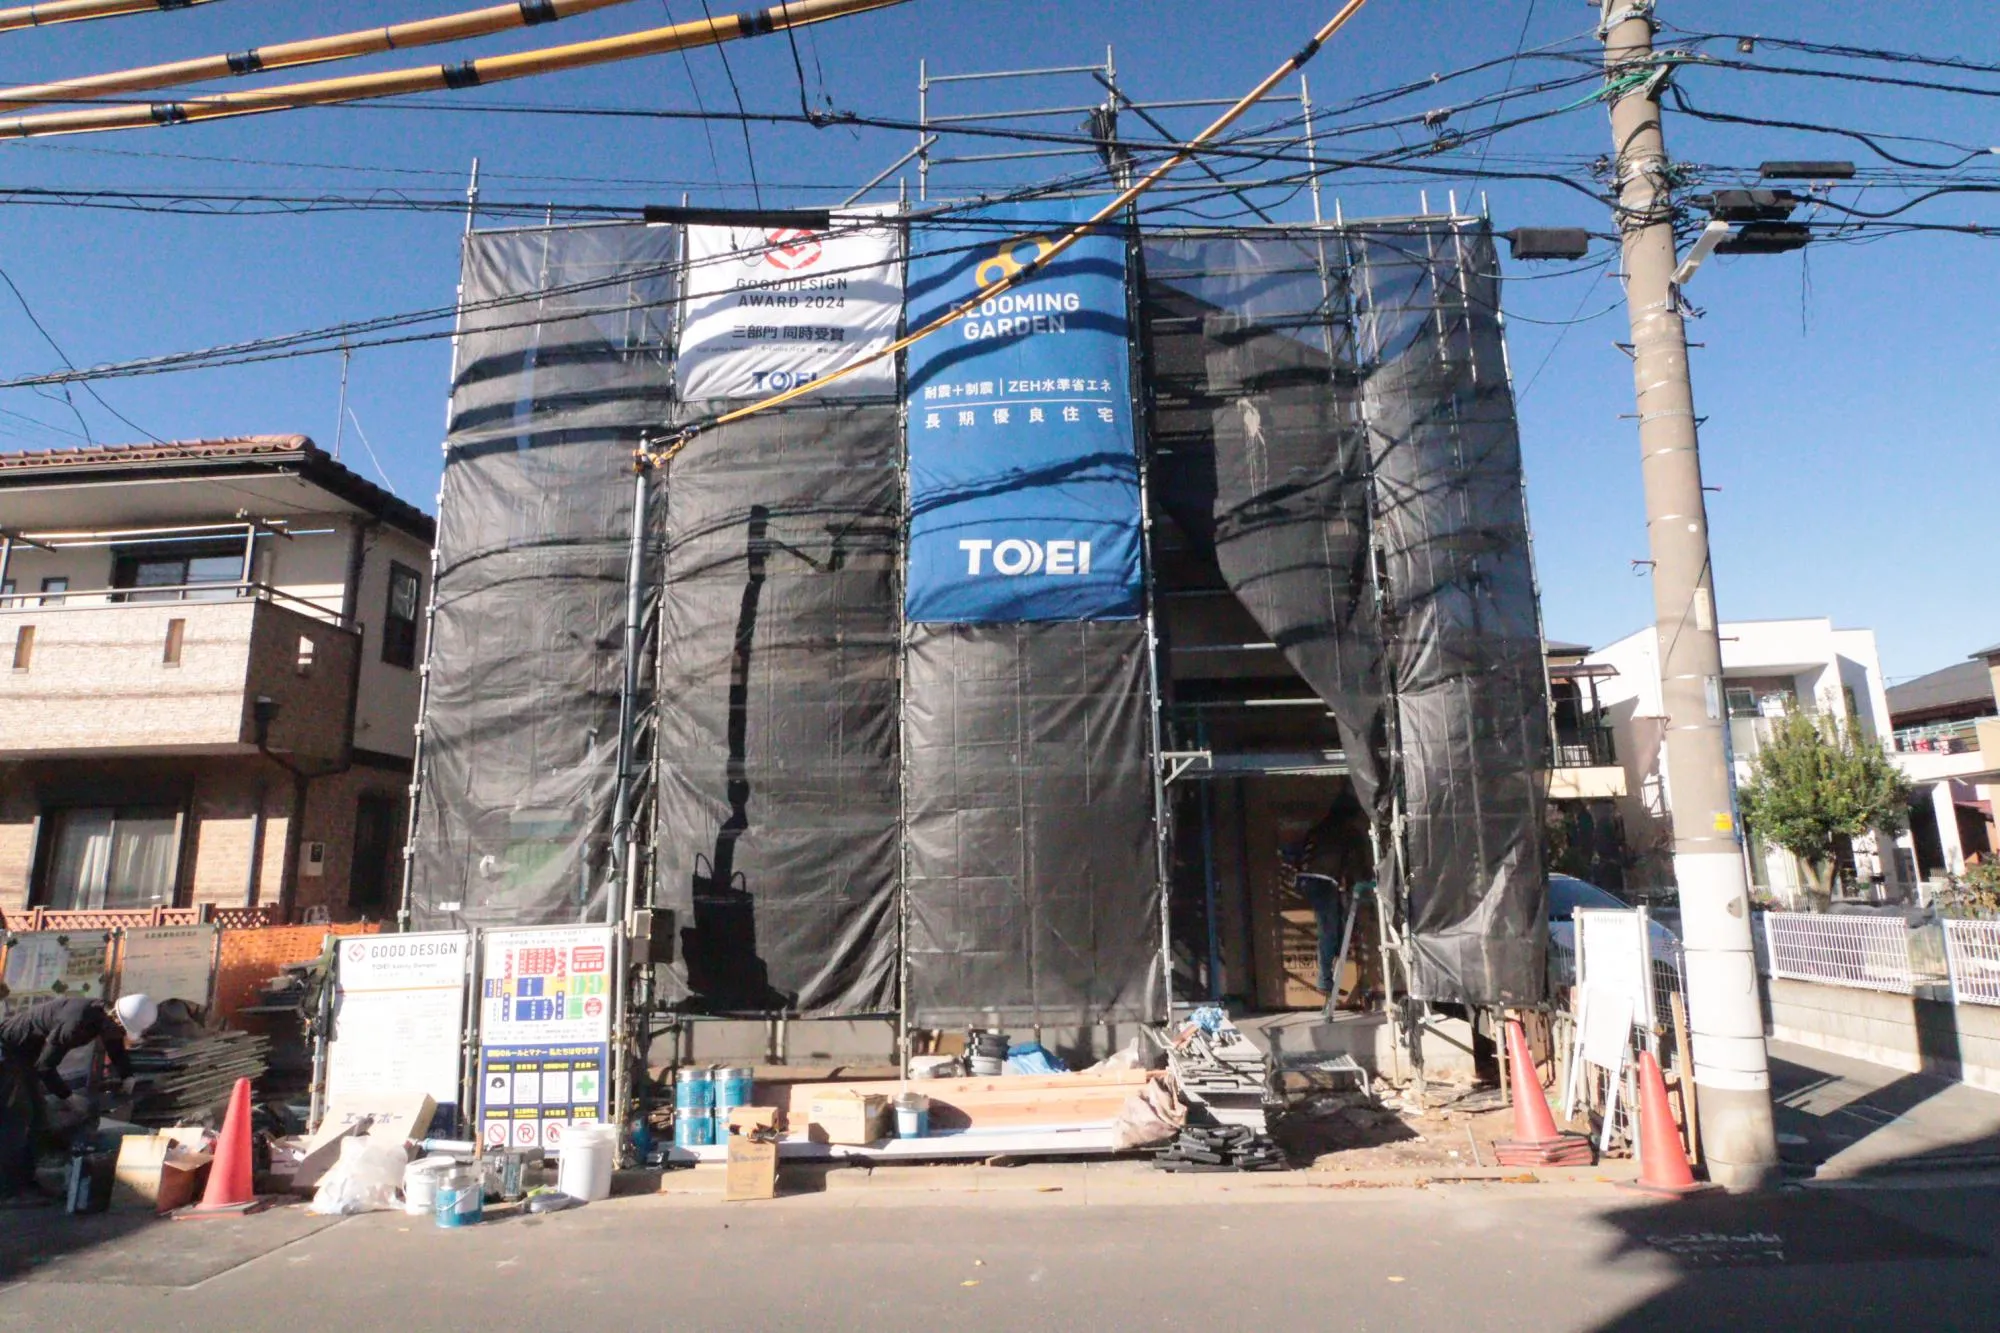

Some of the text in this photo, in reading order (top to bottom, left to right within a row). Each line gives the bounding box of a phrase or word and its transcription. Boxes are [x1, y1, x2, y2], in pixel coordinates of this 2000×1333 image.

[736, 277, 848, 291] GOOD DESIGN
[738, 295, 845, 309] AWARD 2024
[732, 325, 845, 342] 三部門 同時受賞
[963, 315, 1066, 340] GARDEN
[1008, 378, 1112, 393] ZEH水準省エネ
[925, 406, 1113, 429] 長期優良住宅
[959, 539, 1091, 575] TOEI
[371, 942, 457, 958] GOOD DESIGN
